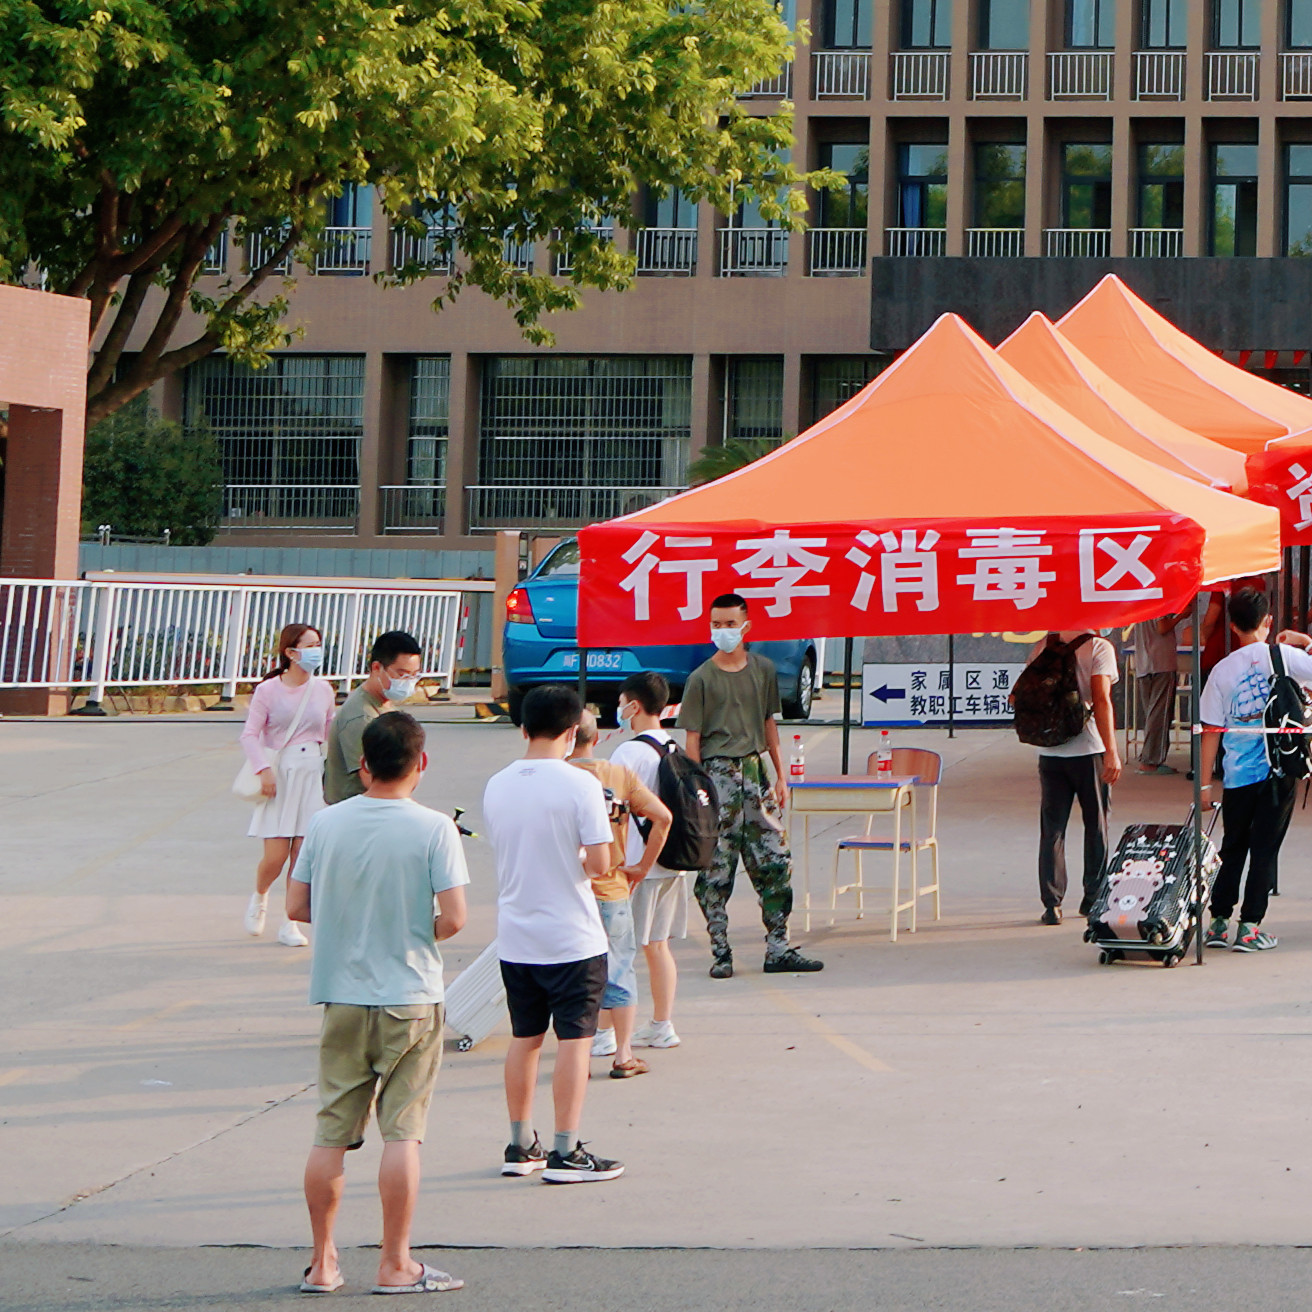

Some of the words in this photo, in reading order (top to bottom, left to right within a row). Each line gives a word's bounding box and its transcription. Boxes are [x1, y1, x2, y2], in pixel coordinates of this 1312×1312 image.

[618, 524, 1165, 622] 行李消毒区
